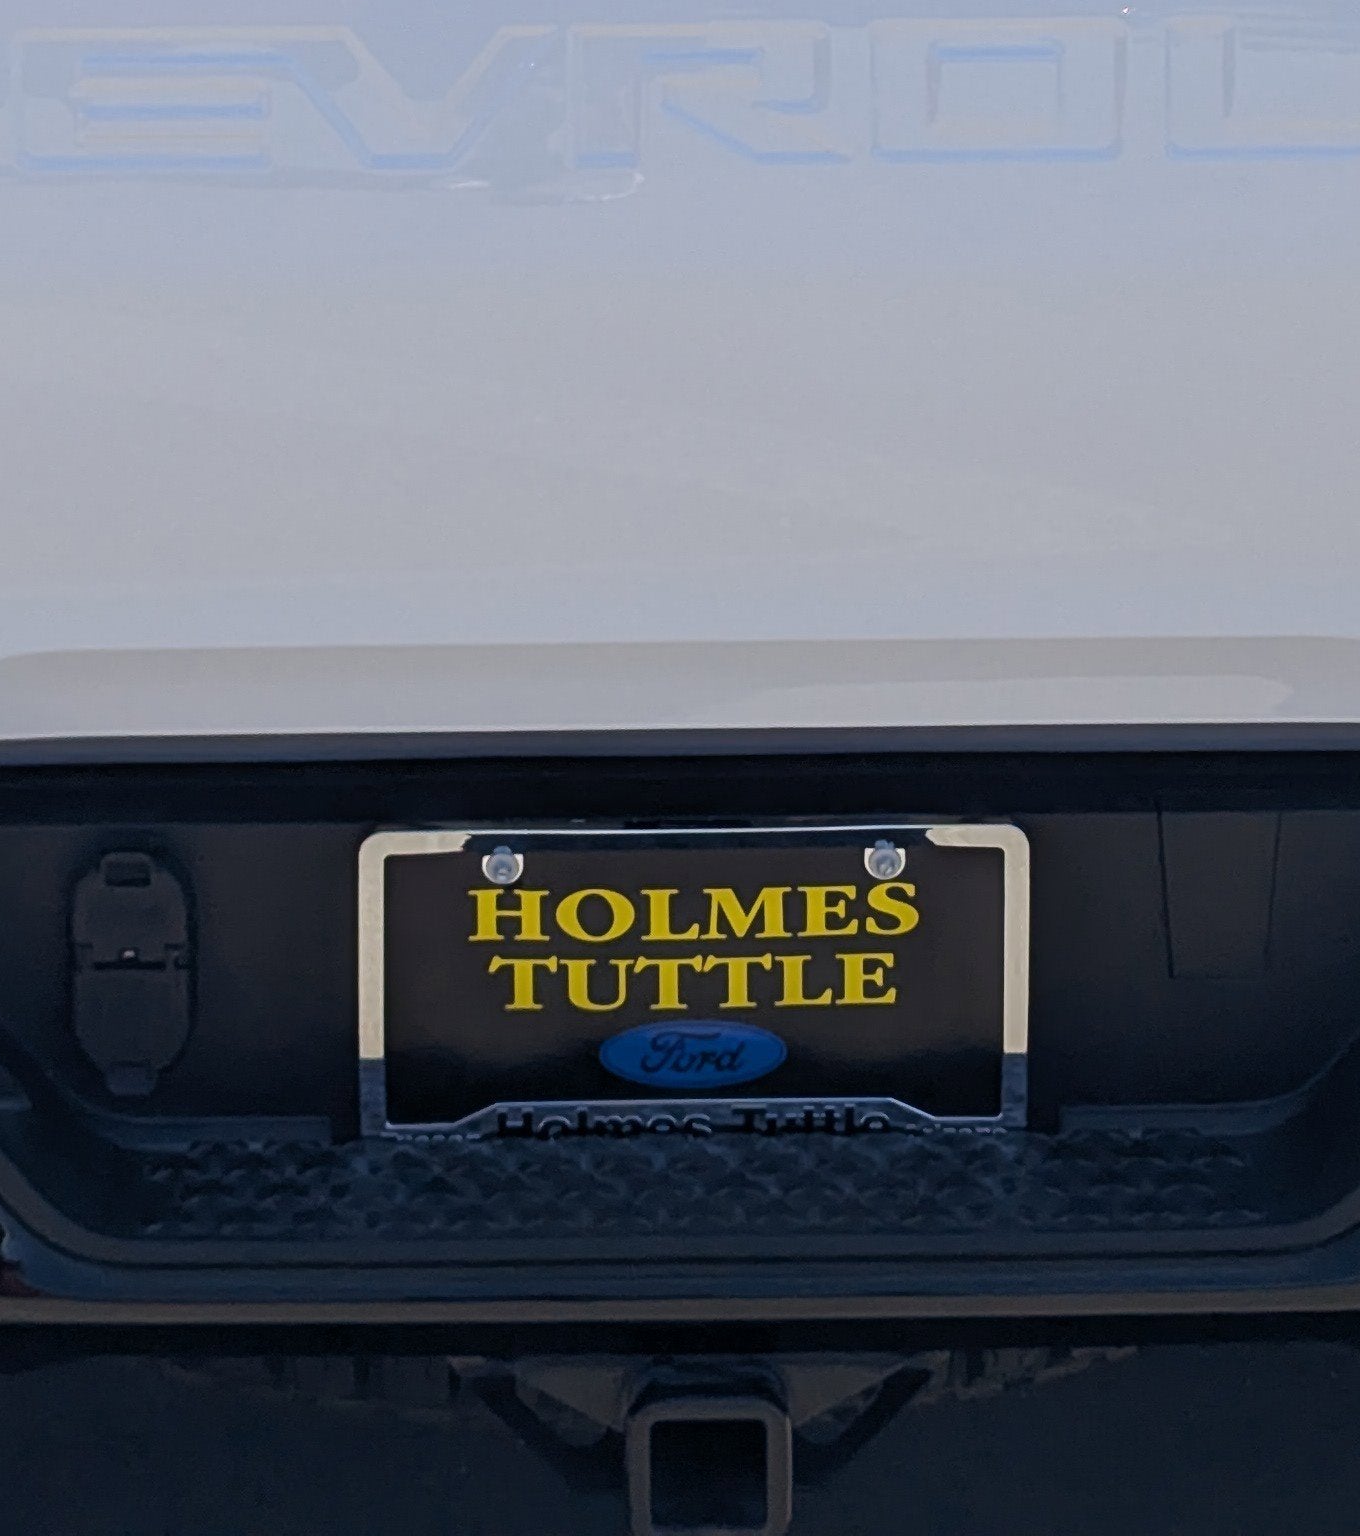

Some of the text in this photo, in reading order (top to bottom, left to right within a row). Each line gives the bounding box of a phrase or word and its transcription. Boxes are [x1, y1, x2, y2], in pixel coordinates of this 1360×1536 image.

[467, 881, 920, 942] HOLMES
[487, 952, 898, 1011] TUTTLE
[641, 1031, 744, 1075] Ford
